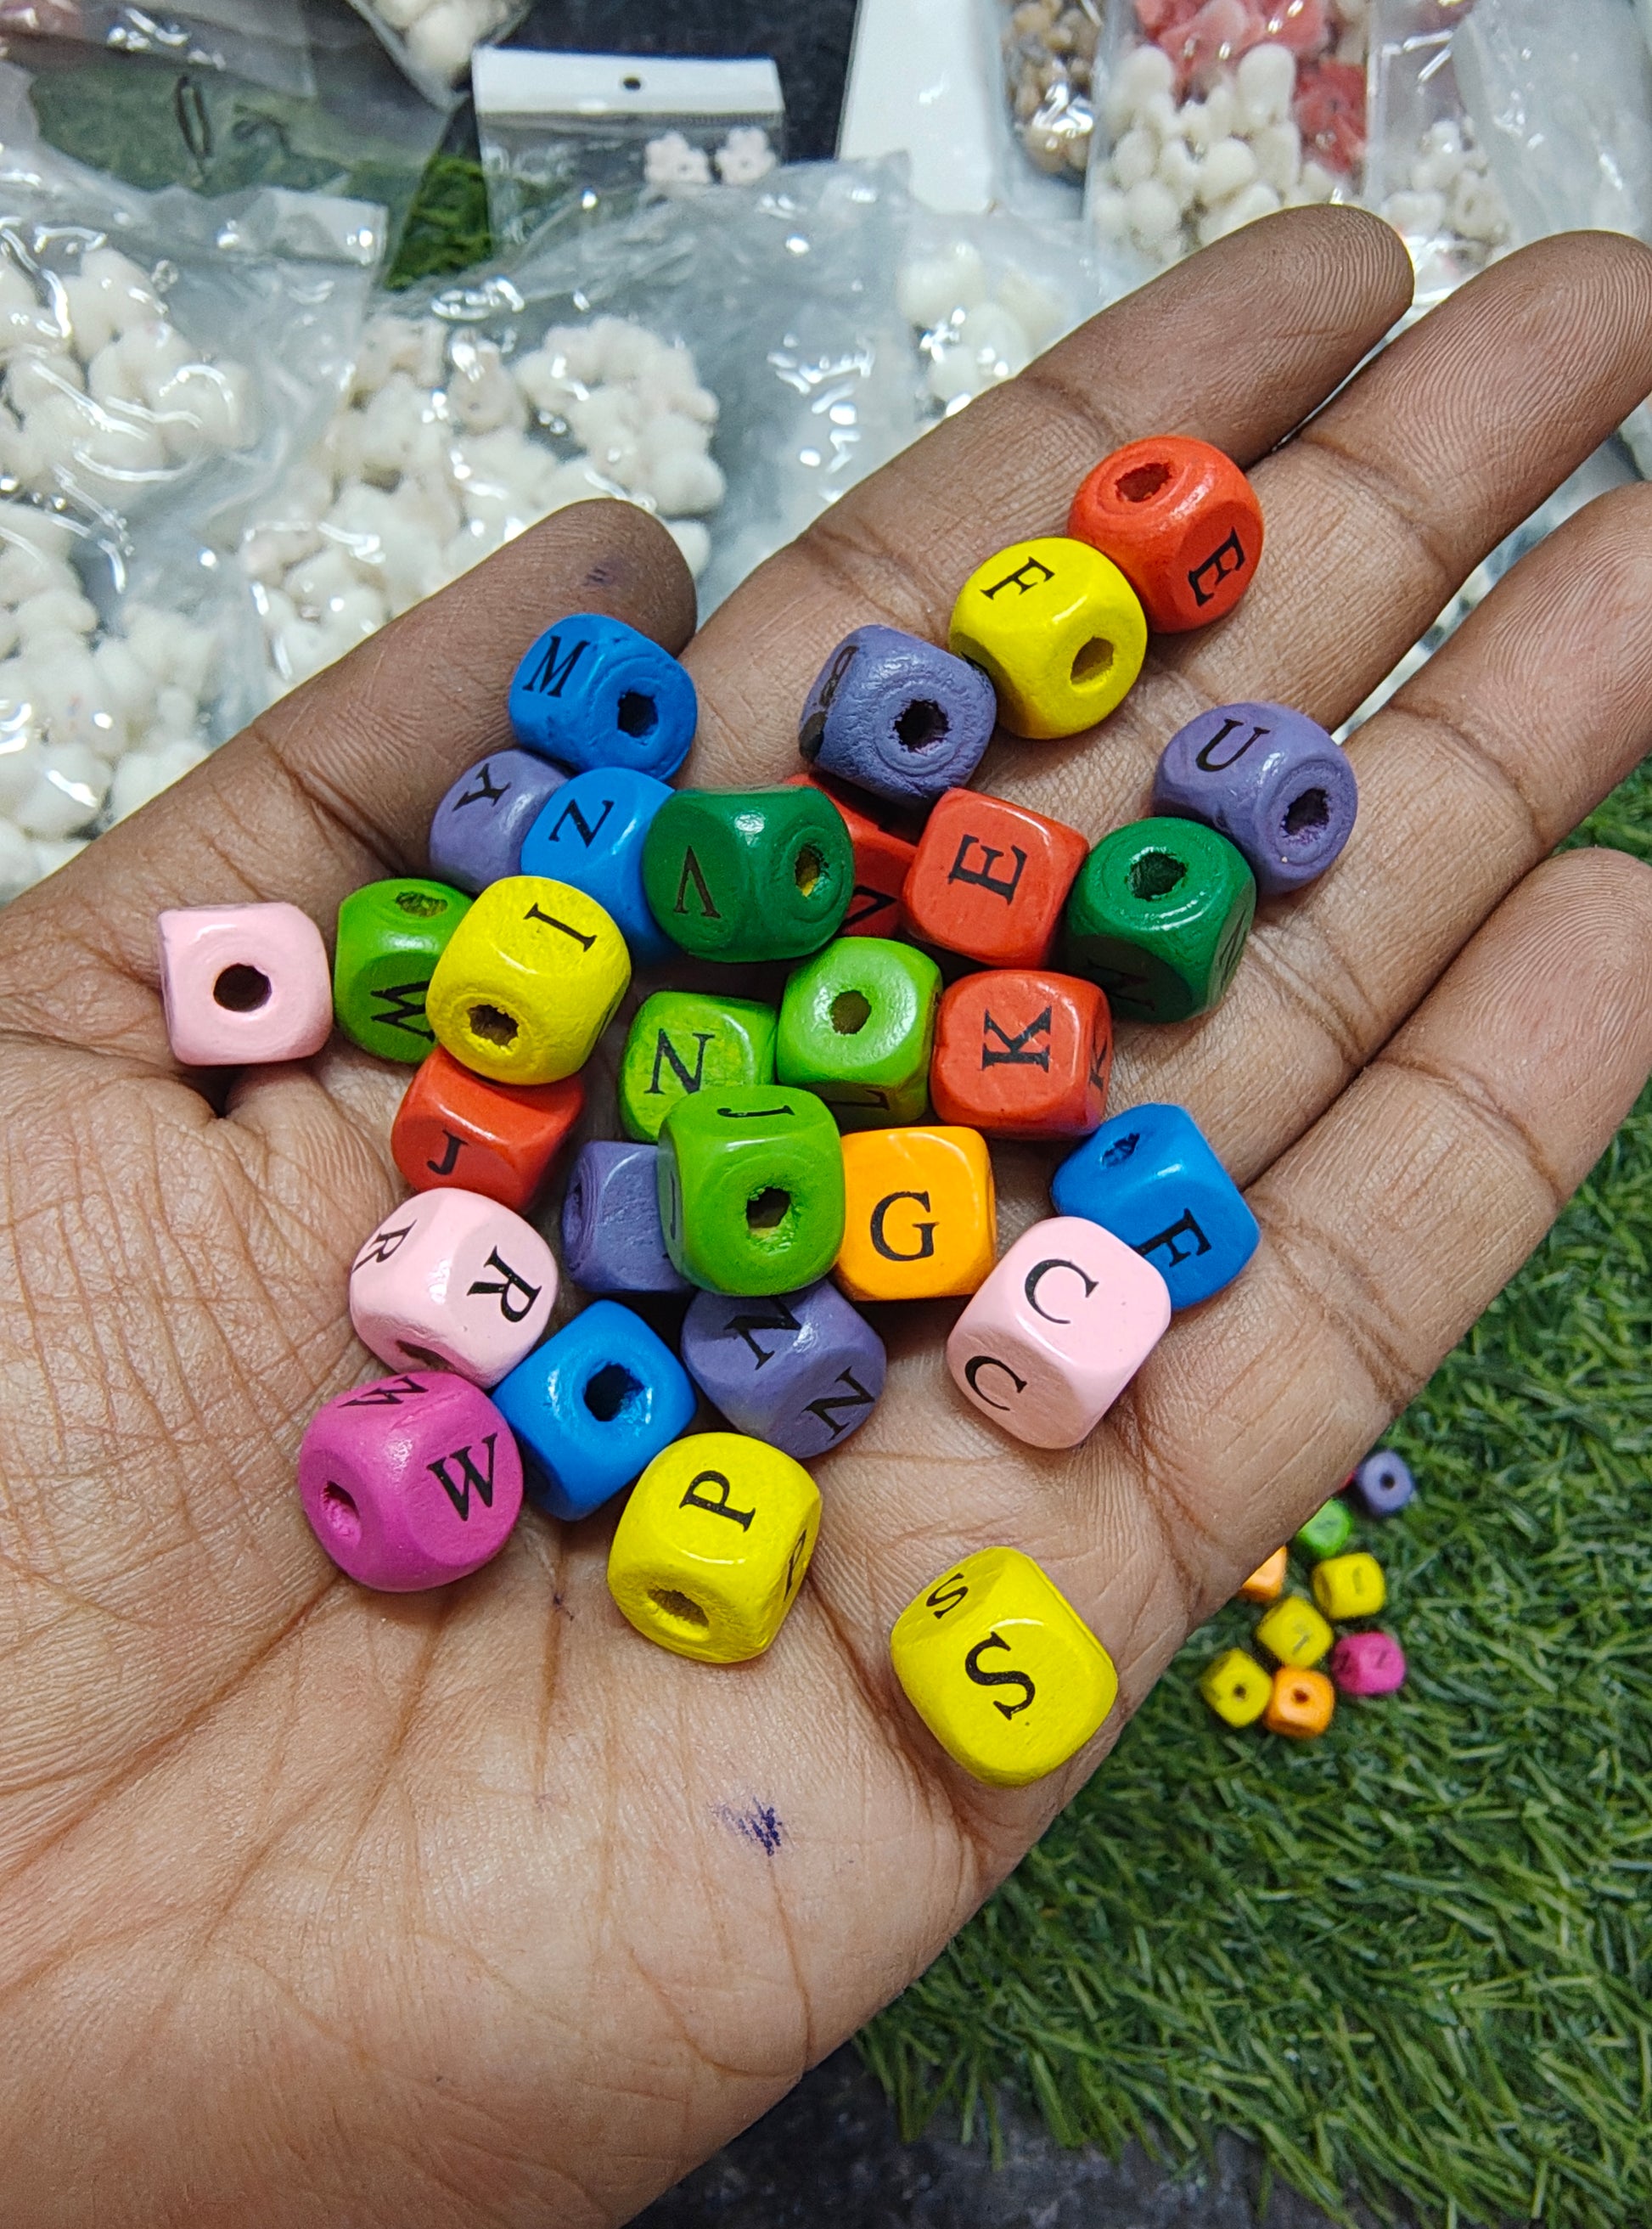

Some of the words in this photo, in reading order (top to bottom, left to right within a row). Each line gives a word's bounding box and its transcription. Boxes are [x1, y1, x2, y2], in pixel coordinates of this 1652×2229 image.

[981, 556, 1055, 599] F
[1188, 526, 1246, 608] E
[522, 636, 591, 697] M
[1195, 718, 1270, 772] U
[453, 763, 511, 811] Y
[674, 846, 721, 919] V
[948, 834, 1028, 905] E
[523, 903, 598, 952] I
[371, 979, 435, 1044] W
[981, 1005, 1053, 1073] K
[644, 1028, 715, 1095] N
[427, 1129, 469, 1175] J
[351, 1219, 417, 1273] R
[870, 1190, 940, 1262] G
[1131, 1208, 1211, 1268] F
[467, 1245, 542, 1323] R
[1025, 1258, 1099, 1325] C
[724, 1296, 801, 1371] N
[801, 1365, 875, 1441] N
[964, 1355, 1027, 1412] C
[427, 1433, 498, 1522] W
[679, 1470, 756, 1533] P
[926, 1573, 970, 1619] S
[964, 1632, 1037, 1720] S
